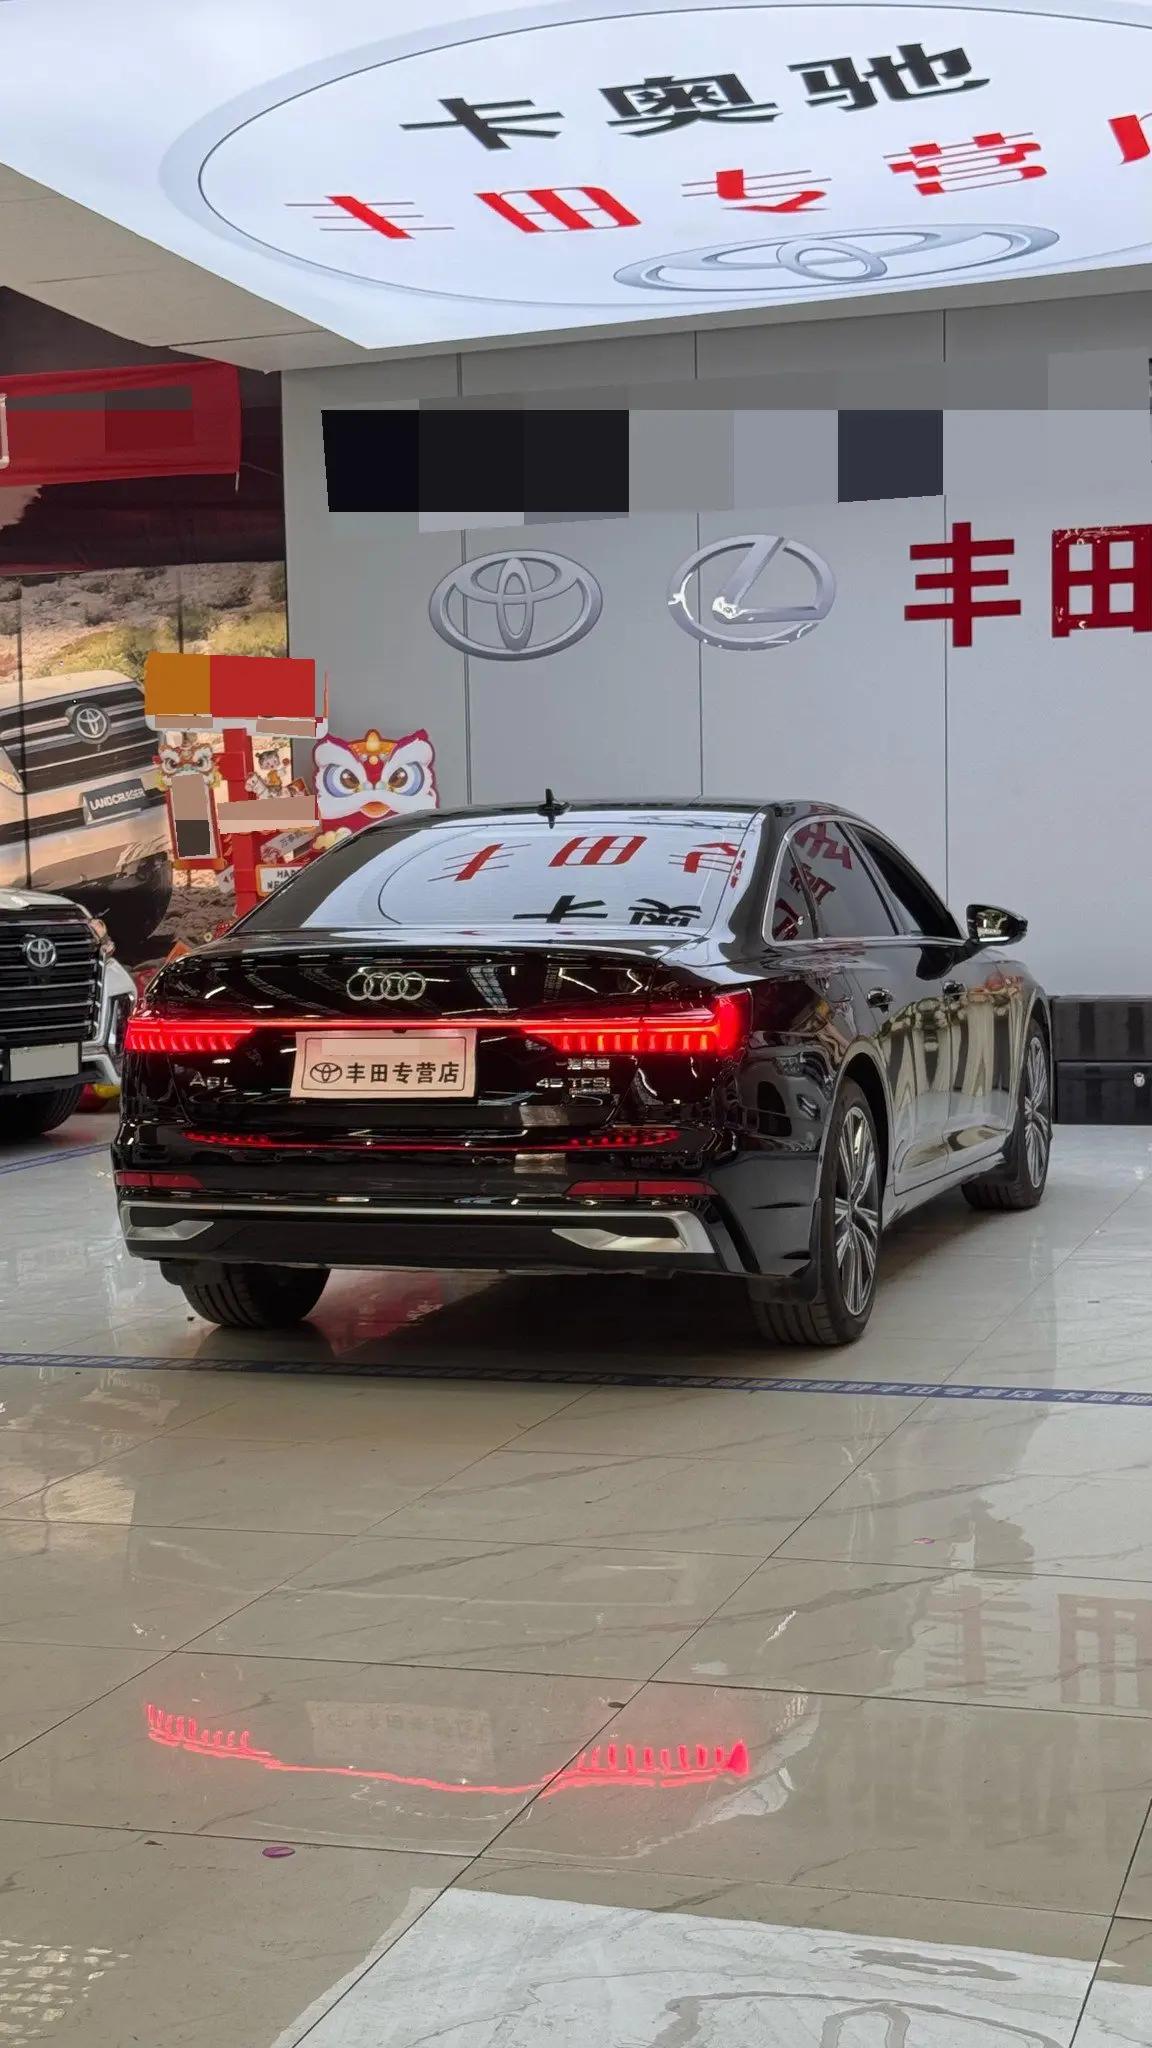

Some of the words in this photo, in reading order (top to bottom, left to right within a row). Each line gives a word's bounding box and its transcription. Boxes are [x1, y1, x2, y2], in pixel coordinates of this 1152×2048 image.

[401, 42, 992, 151] 卡奥驰
[904, 522, 1152, 647] 丰田
[346, 1061, 460, 1084] 丰田专营店
[536, 1077, 564, 1089] 45
[567, 1077, 611, 1089] TFSI
